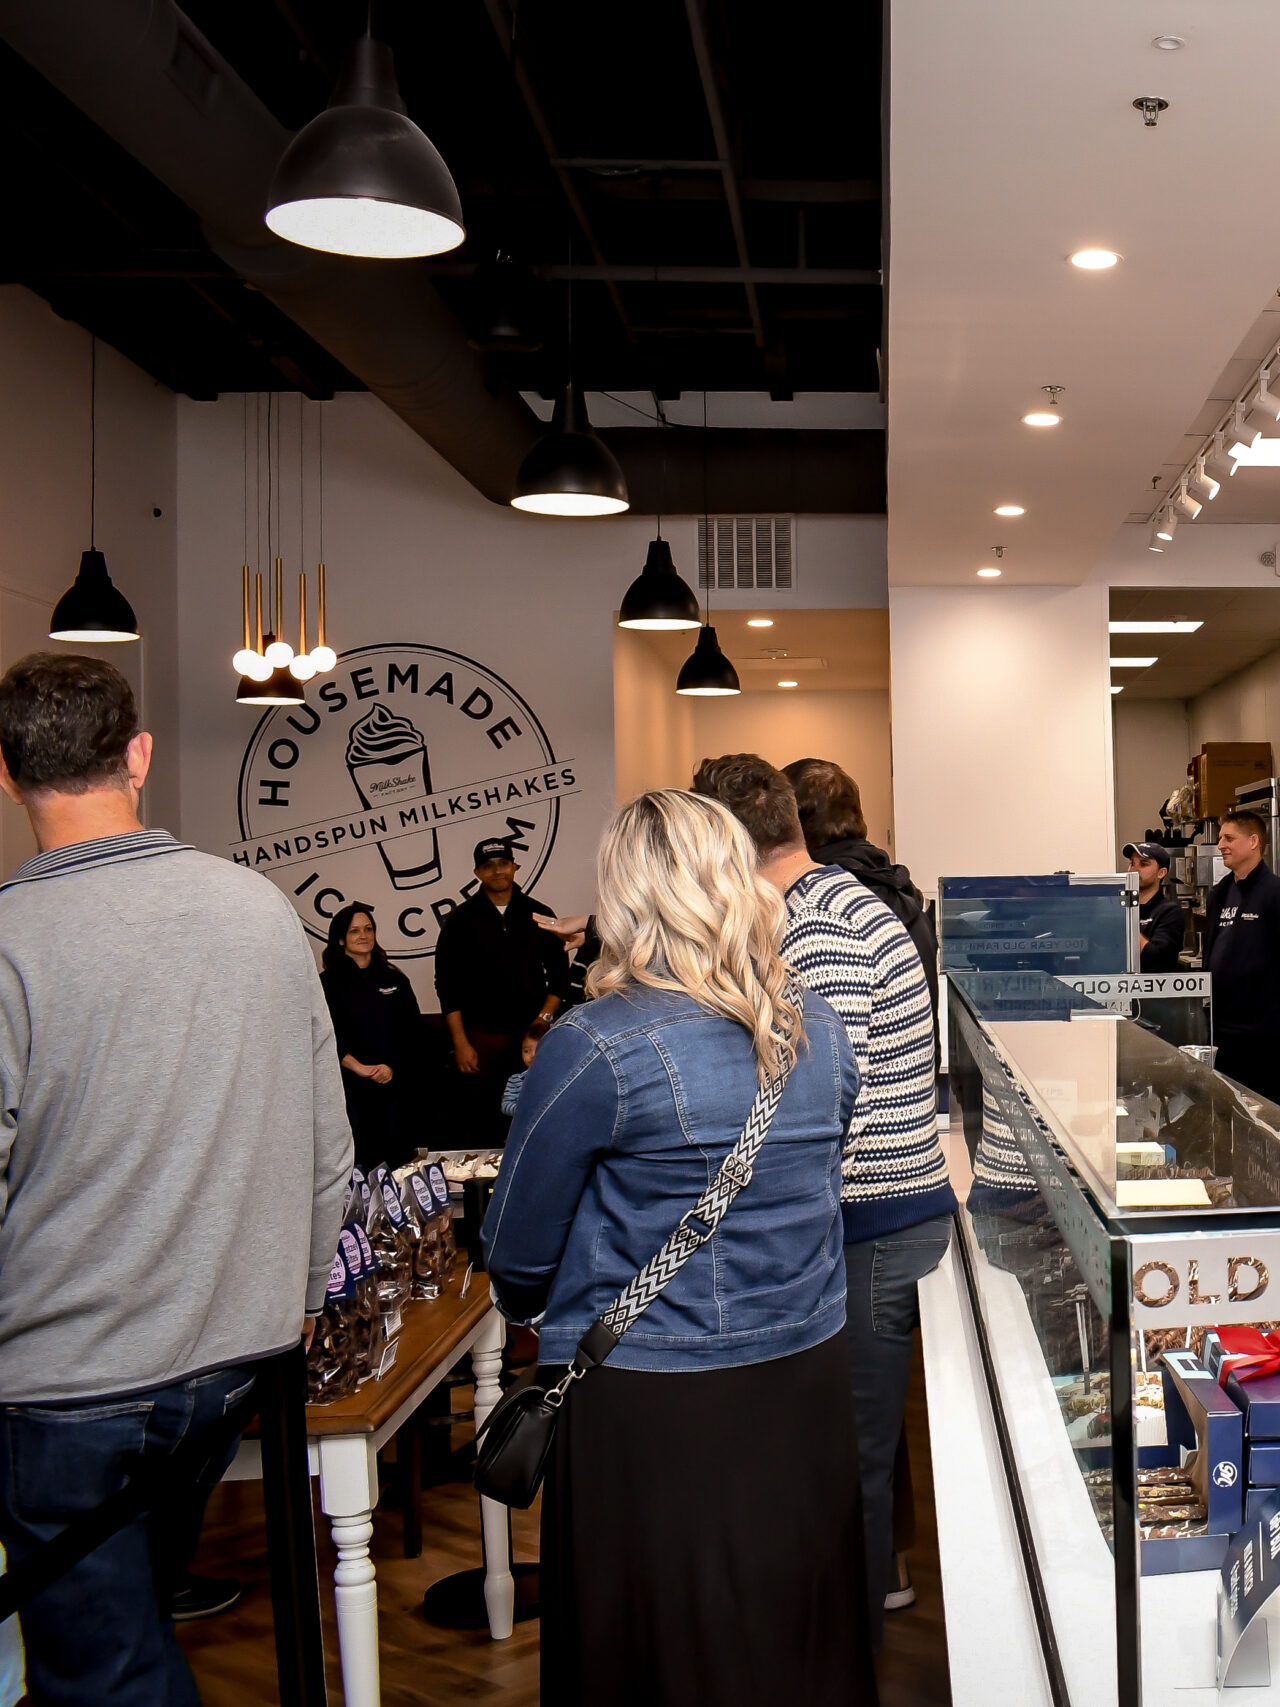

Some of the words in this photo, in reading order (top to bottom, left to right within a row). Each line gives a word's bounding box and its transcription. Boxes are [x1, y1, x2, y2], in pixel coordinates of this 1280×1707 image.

[258, 663, 523, 807] HOUSEMADE
[232, 815, 389, 867] HANDSPUN
[399, 768, 577, 828] MILKSHAKES
[1132, 1252, 1270, 1309] OLD
